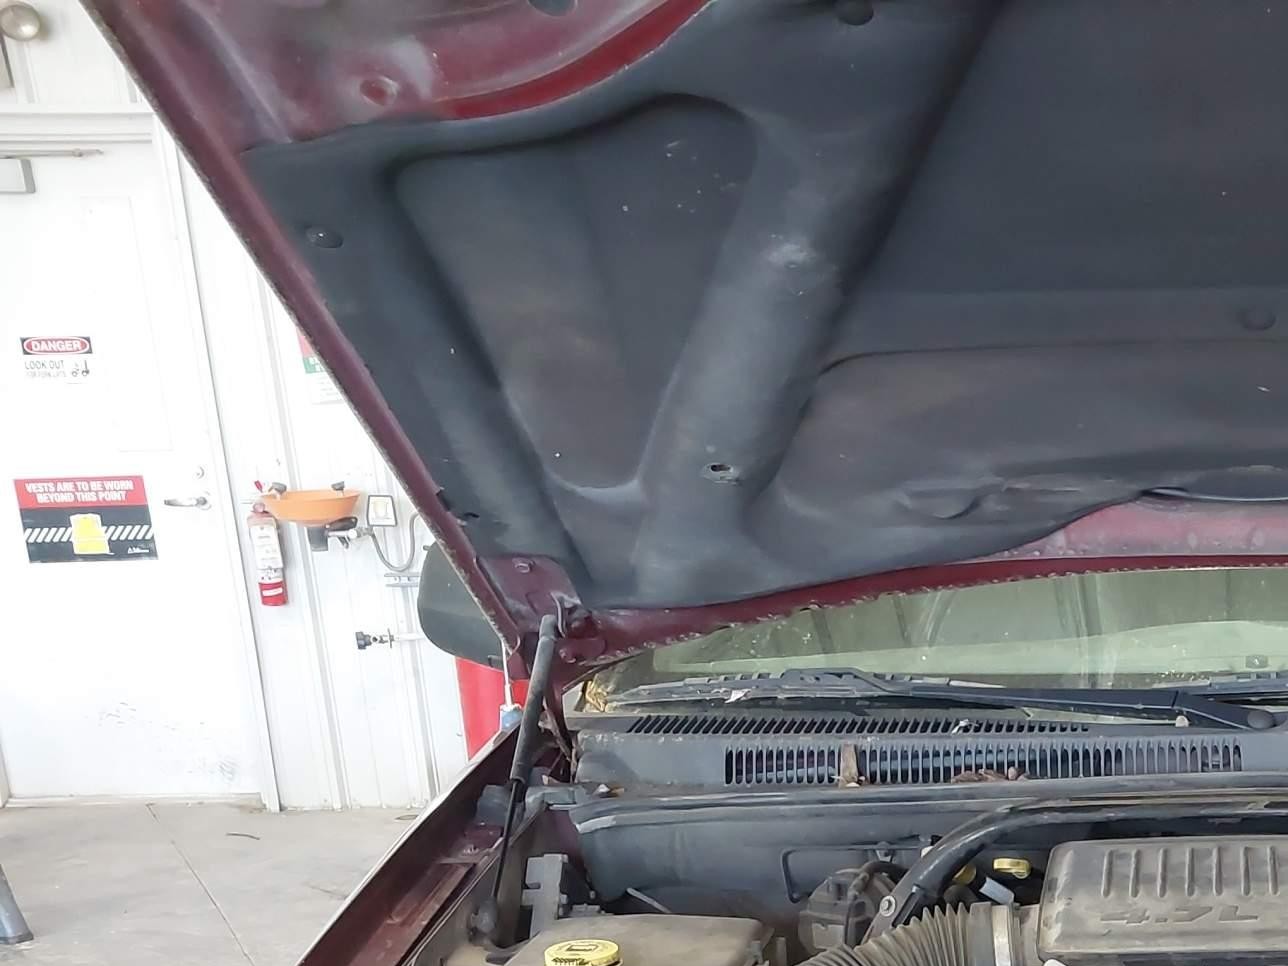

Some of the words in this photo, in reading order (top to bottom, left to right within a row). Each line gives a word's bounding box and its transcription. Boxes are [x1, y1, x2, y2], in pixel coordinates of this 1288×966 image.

[31, 340, 82, 352] DANGER
[24, 360, 47, 370] LOOK
[48, 360, 64, 369] OUT
[25, 481, 56, 493] VESTS
[56, 481, 76, 492] ARE
[76, 481, 90, 491] TO
[90, 480, 104, 491] BE
[103, 480, 134, 491] WORN
[36, 492, 75, 503] BEYOND
[75, 491, 97, 502] THIS
[97, 490, 127, 501] POINT
[1100, 904, 1259, 926] 4.7L
